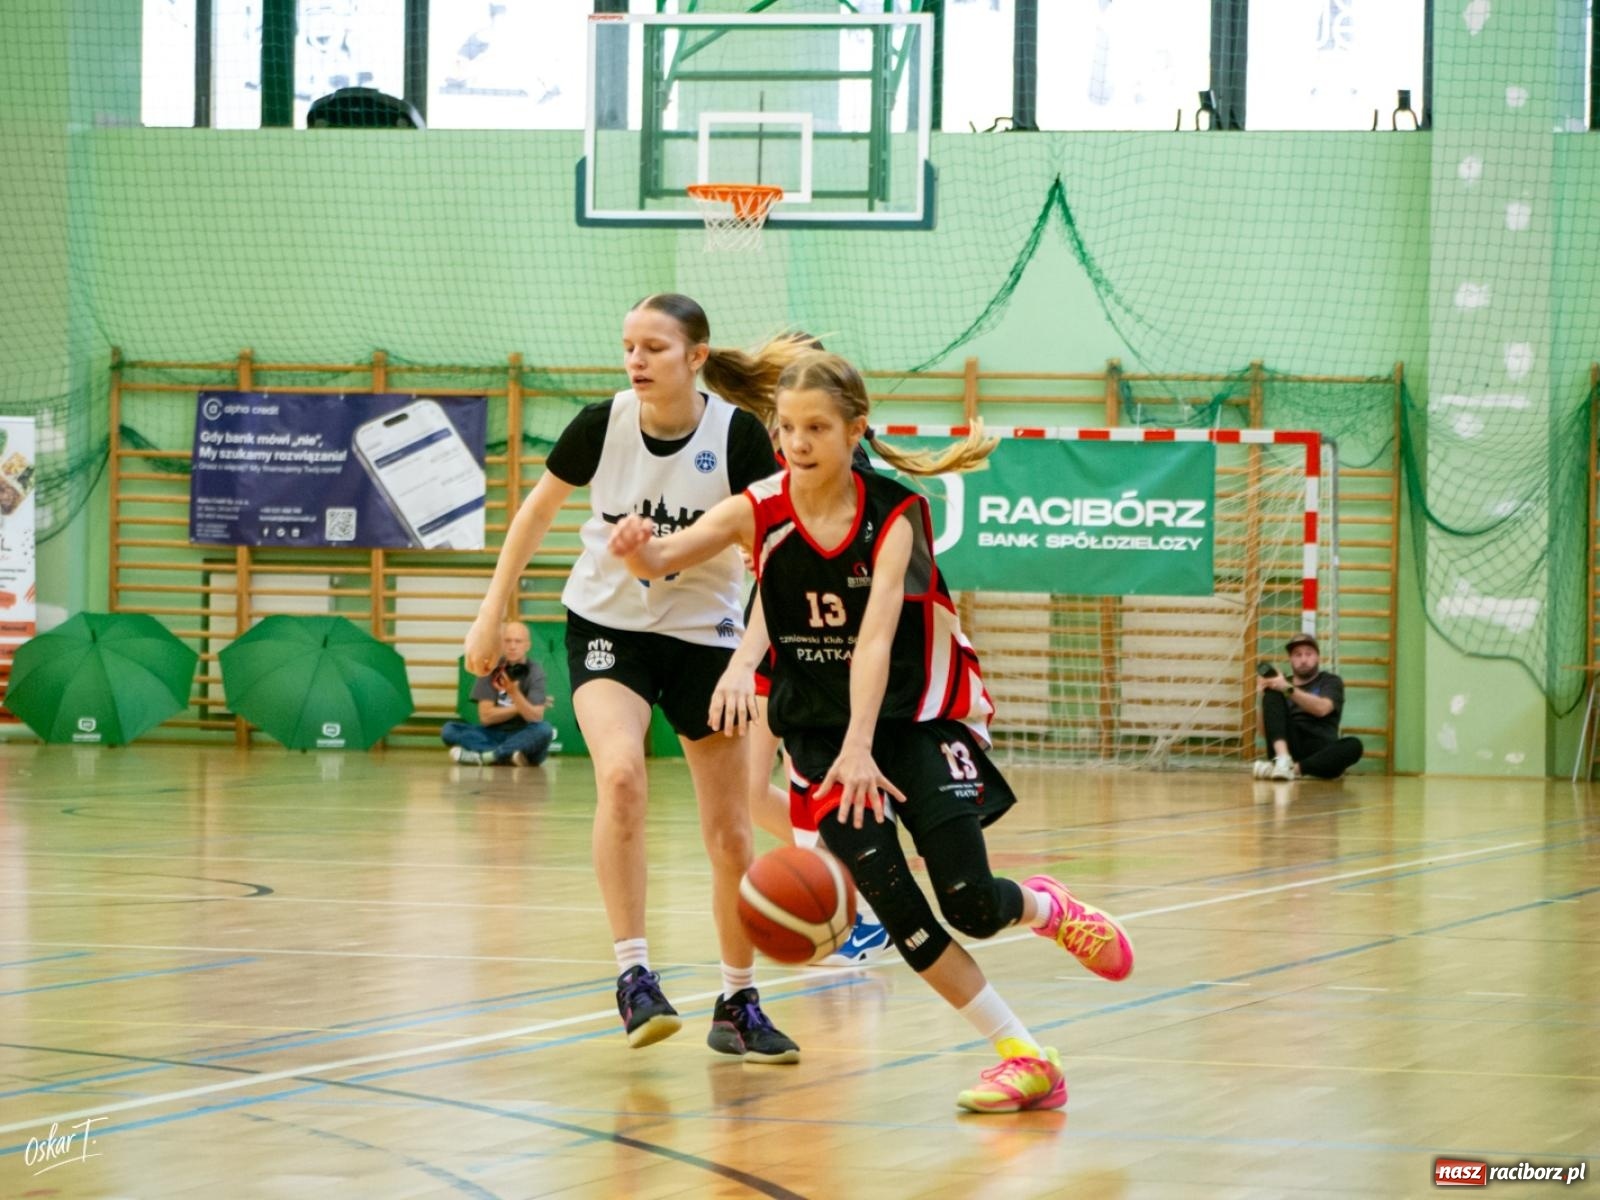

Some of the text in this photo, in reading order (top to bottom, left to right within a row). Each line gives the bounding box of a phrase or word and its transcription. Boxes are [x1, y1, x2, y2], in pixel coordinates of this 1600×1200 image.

[224, 404, 279, 417] alpha credit
[200, 431, 224, 446] Gdy
[225, 431, 255, 445] bank
[257, 432, 290, 446] mówi
[199, 446, 218, 461] My
[219, 448, 273, 464] szukamy
[978, 489, 1206, 528] RACIBÓRZ
[978, 531, 1203, 551] BANK SPÓŁDZIELCZY
[805, 590, 847, 628] 13
[823, 635, 844, 645] Klub
[796, 648, 854, 663] PIĄTKA
[940, 740, 978, 780] 13
